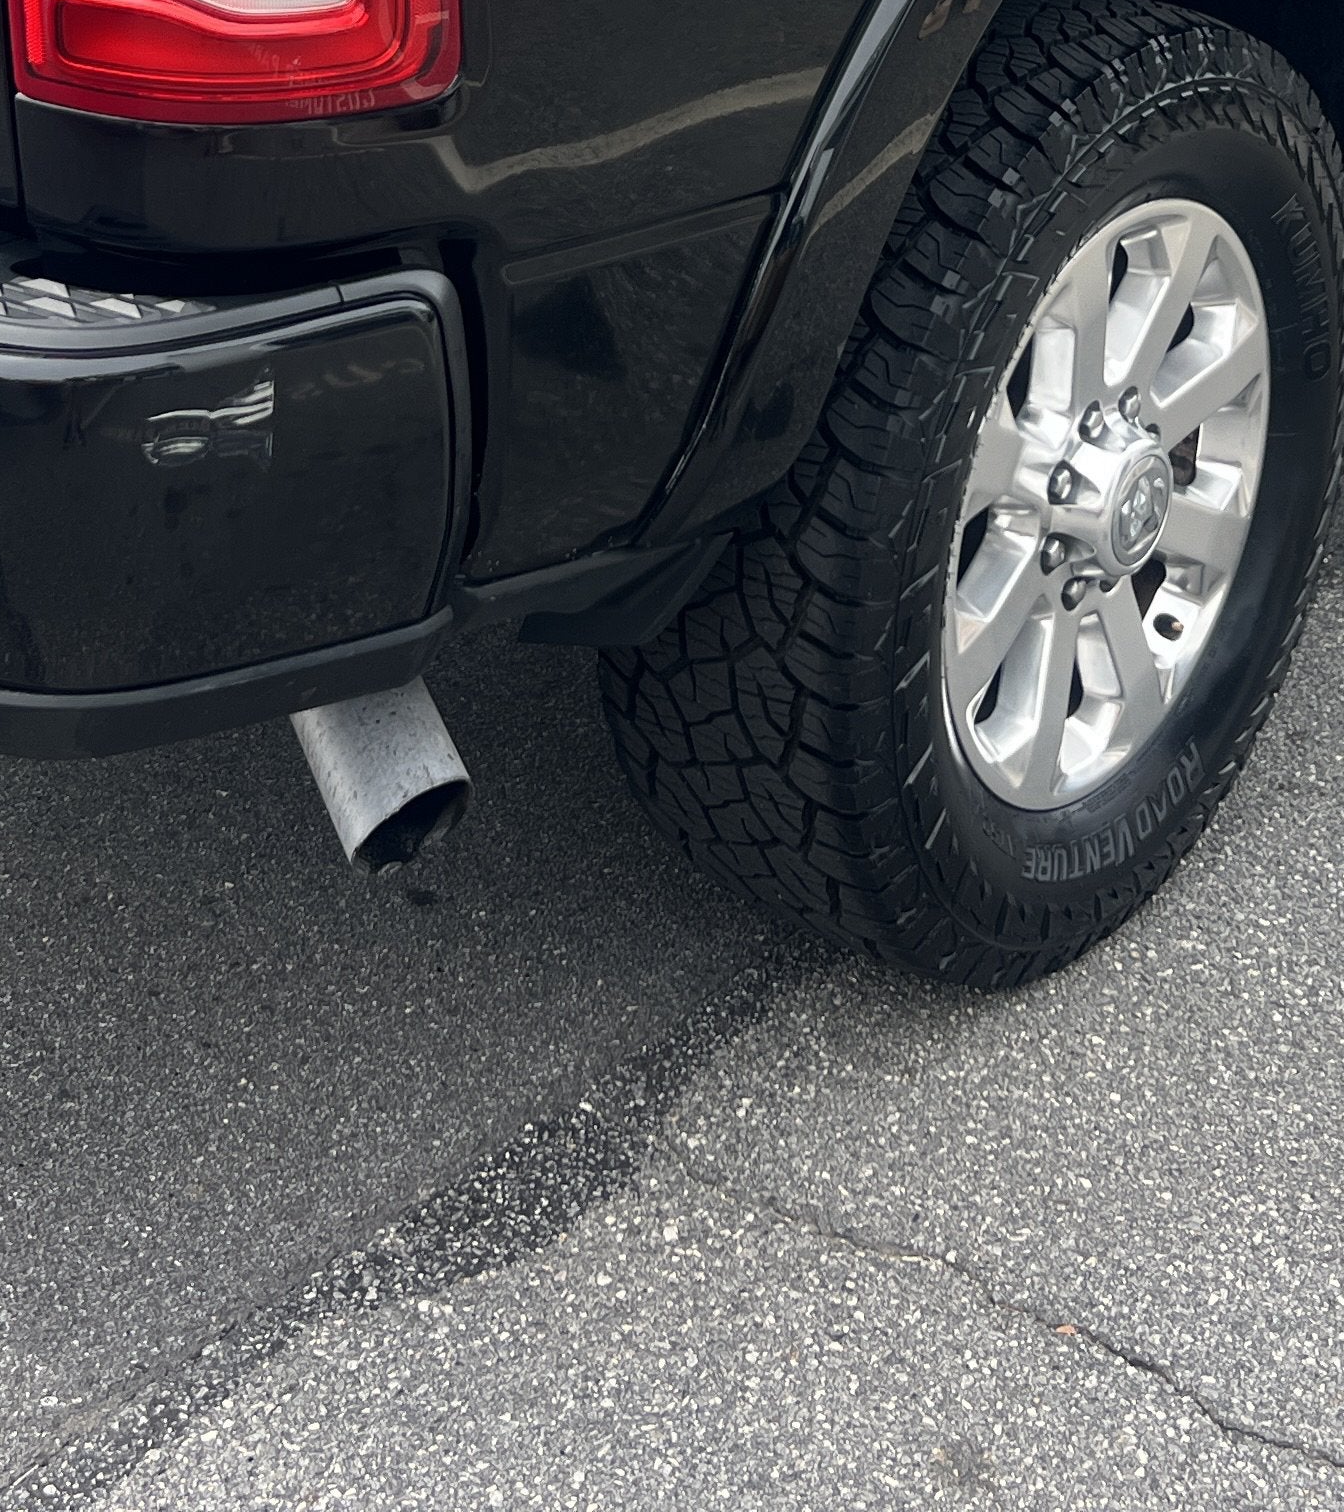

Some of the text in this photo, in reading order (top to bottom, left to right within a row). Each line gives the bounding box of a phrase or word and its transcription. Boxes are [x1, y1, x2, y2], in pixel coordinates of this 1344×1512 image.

[1270, 193, 1331, 384] KUMHO
[1136, 736, 1207, 840] ROAD
[1021, 816, 1135, 882] VENTURE
